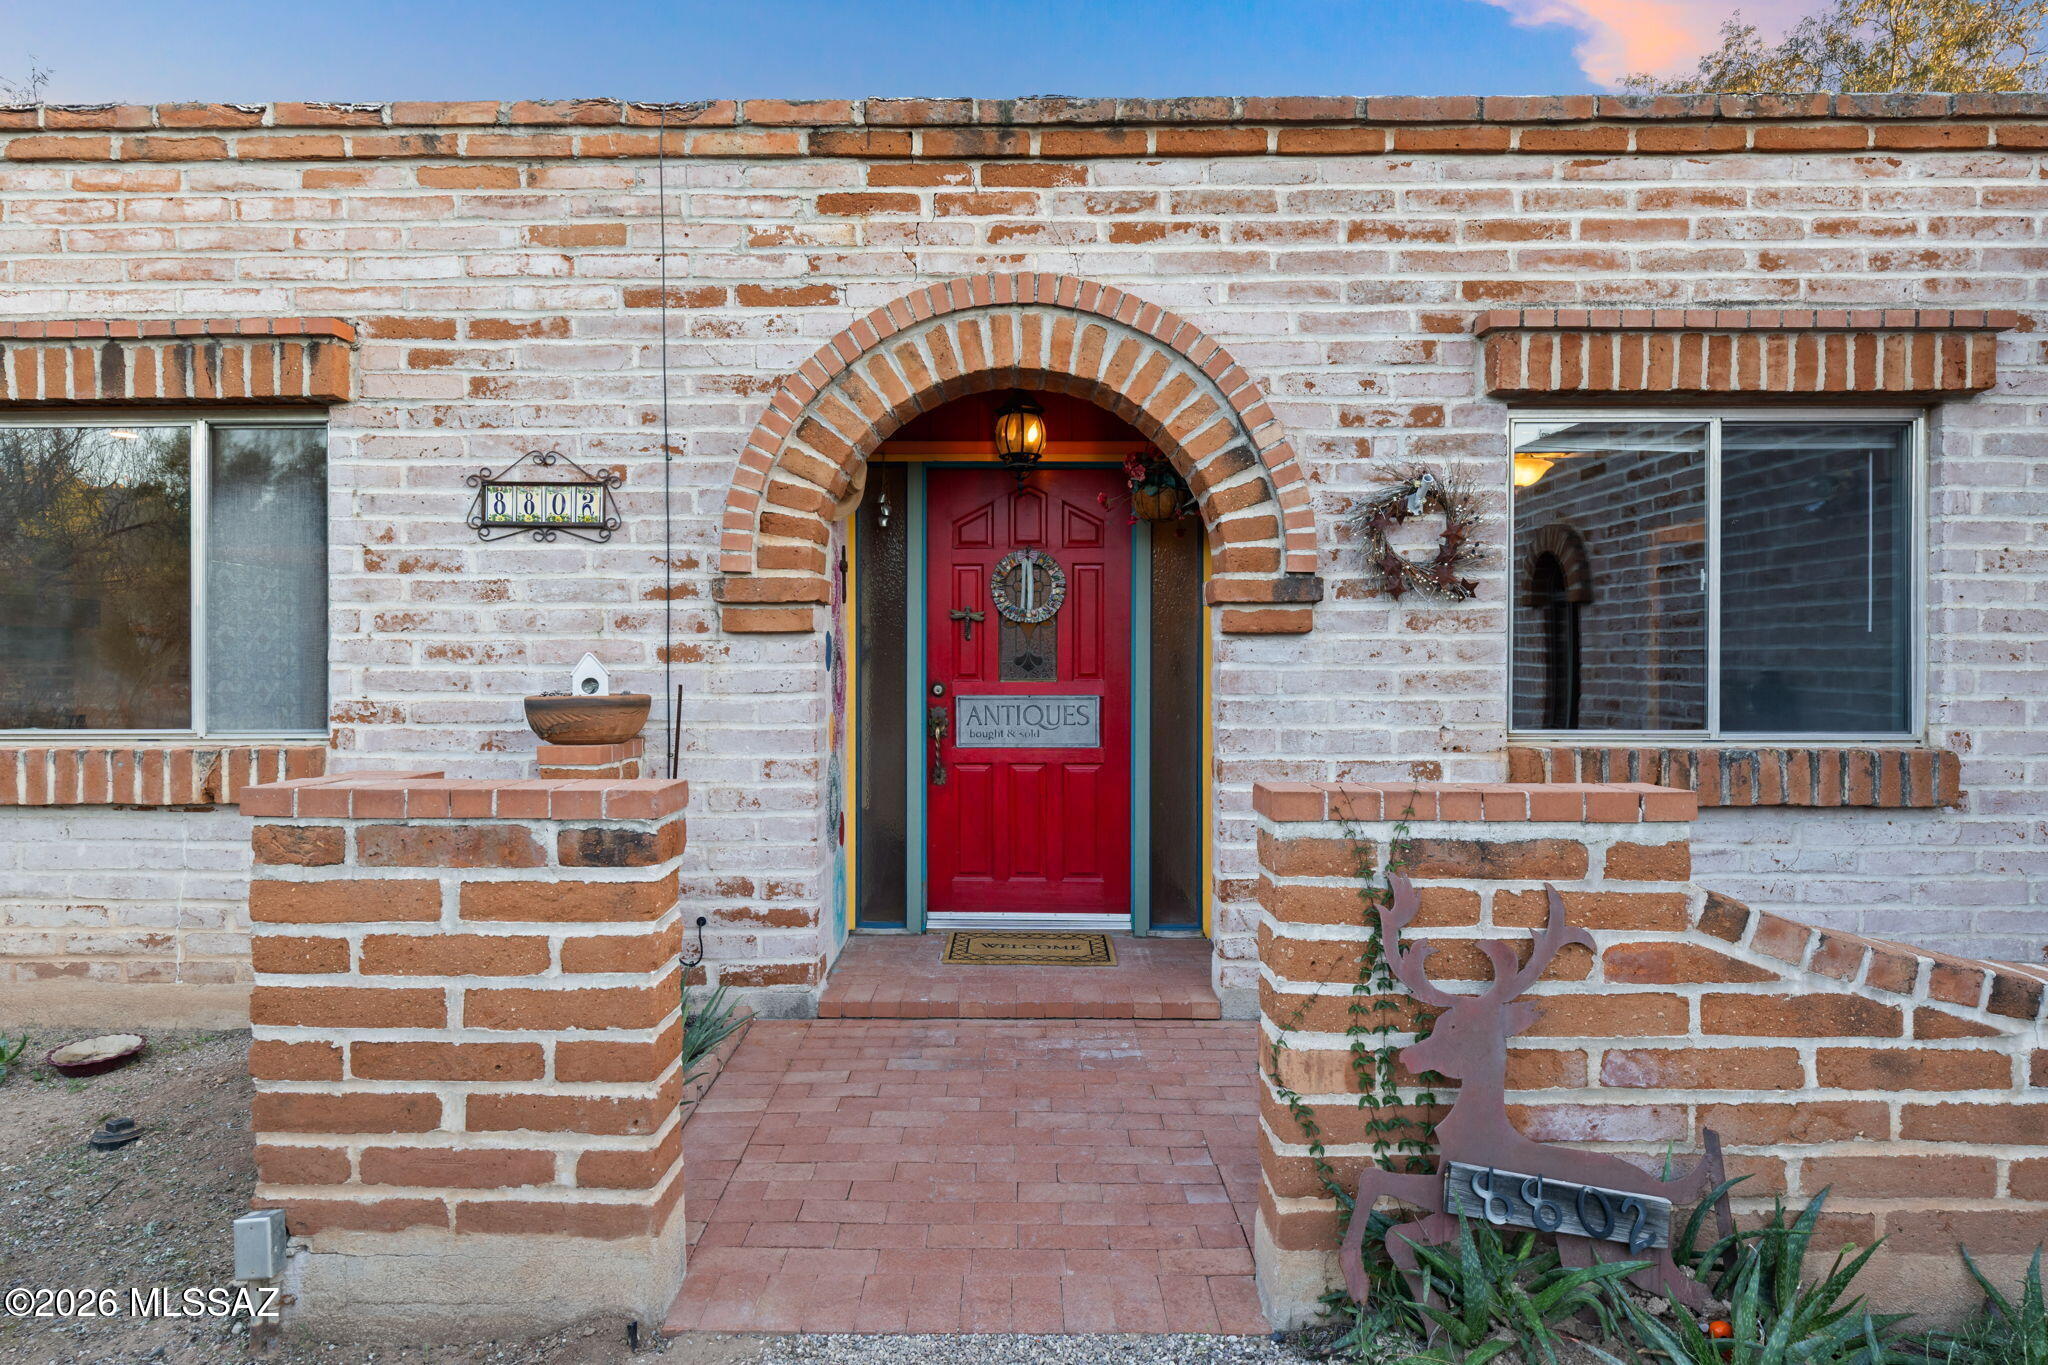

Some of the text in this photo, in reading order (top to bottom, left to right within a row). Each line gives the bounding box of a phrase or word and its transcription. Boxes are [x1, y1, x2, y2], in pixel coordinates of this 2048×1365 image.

[493, 491, 594, 516] 8802
[966, 705, 1090, 730] ANTIQUES
[969, 729, 1040, 740] bought & sold
[981, 942, 1082, 951] WELCOME
[1471, 1166, 1657, 1255] 8802
